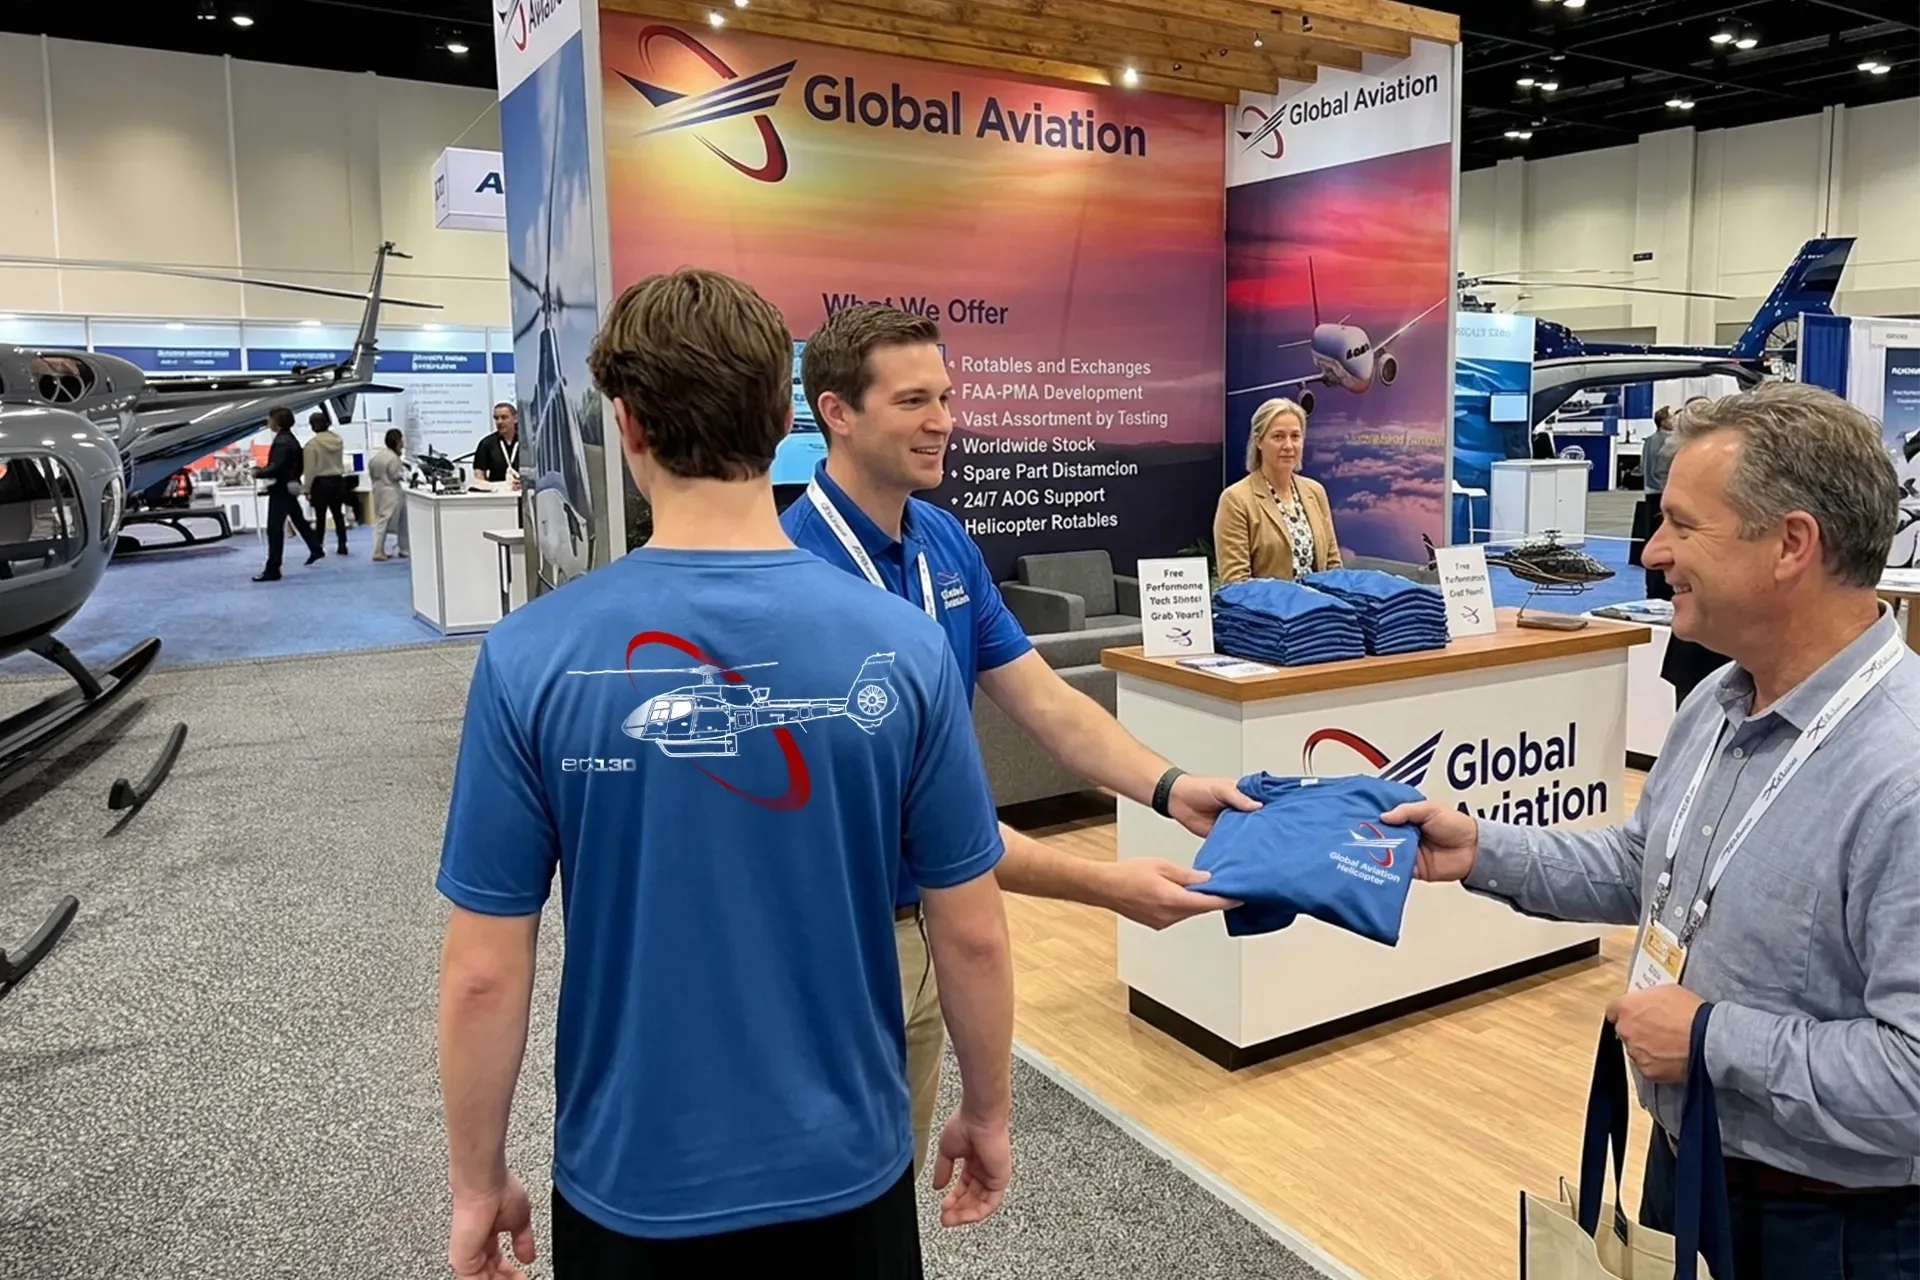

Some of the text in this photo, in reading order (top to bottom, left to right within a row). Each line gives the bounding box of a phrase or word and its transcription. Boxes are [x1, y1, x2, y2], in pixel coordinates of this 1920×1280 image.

[1289, 73, 1438, 126] Global Aviation
[803, 74, 1147, 157] Global Aviation
[899, 296, 940, 322] We
[947, 298, 1009, 325] Offer
[961, 355, 1152, 379] Rotables and Exchanges
[961, 383, 1144, 404] FAA-PMA Development
[961, 410, 999, 427] Vast
[1095, 410, 1115, 430] by
[1117, 409, 1169, 429] Testing
[962, 435, 1097, 454] Worldwide Stock
[962, 464, 1012, 485] Spare
[1015, 463, 1050, 480] Part
[963, 487, 1106, 509] 24/7 AOG Support
[964, 511, 1119, 537] Helicopter Rotables
[1163, 568, 1185, 578] Free
[1446, 721, 1577, 791] Global
[1329, 851, 1401, 884] Global Aviation
